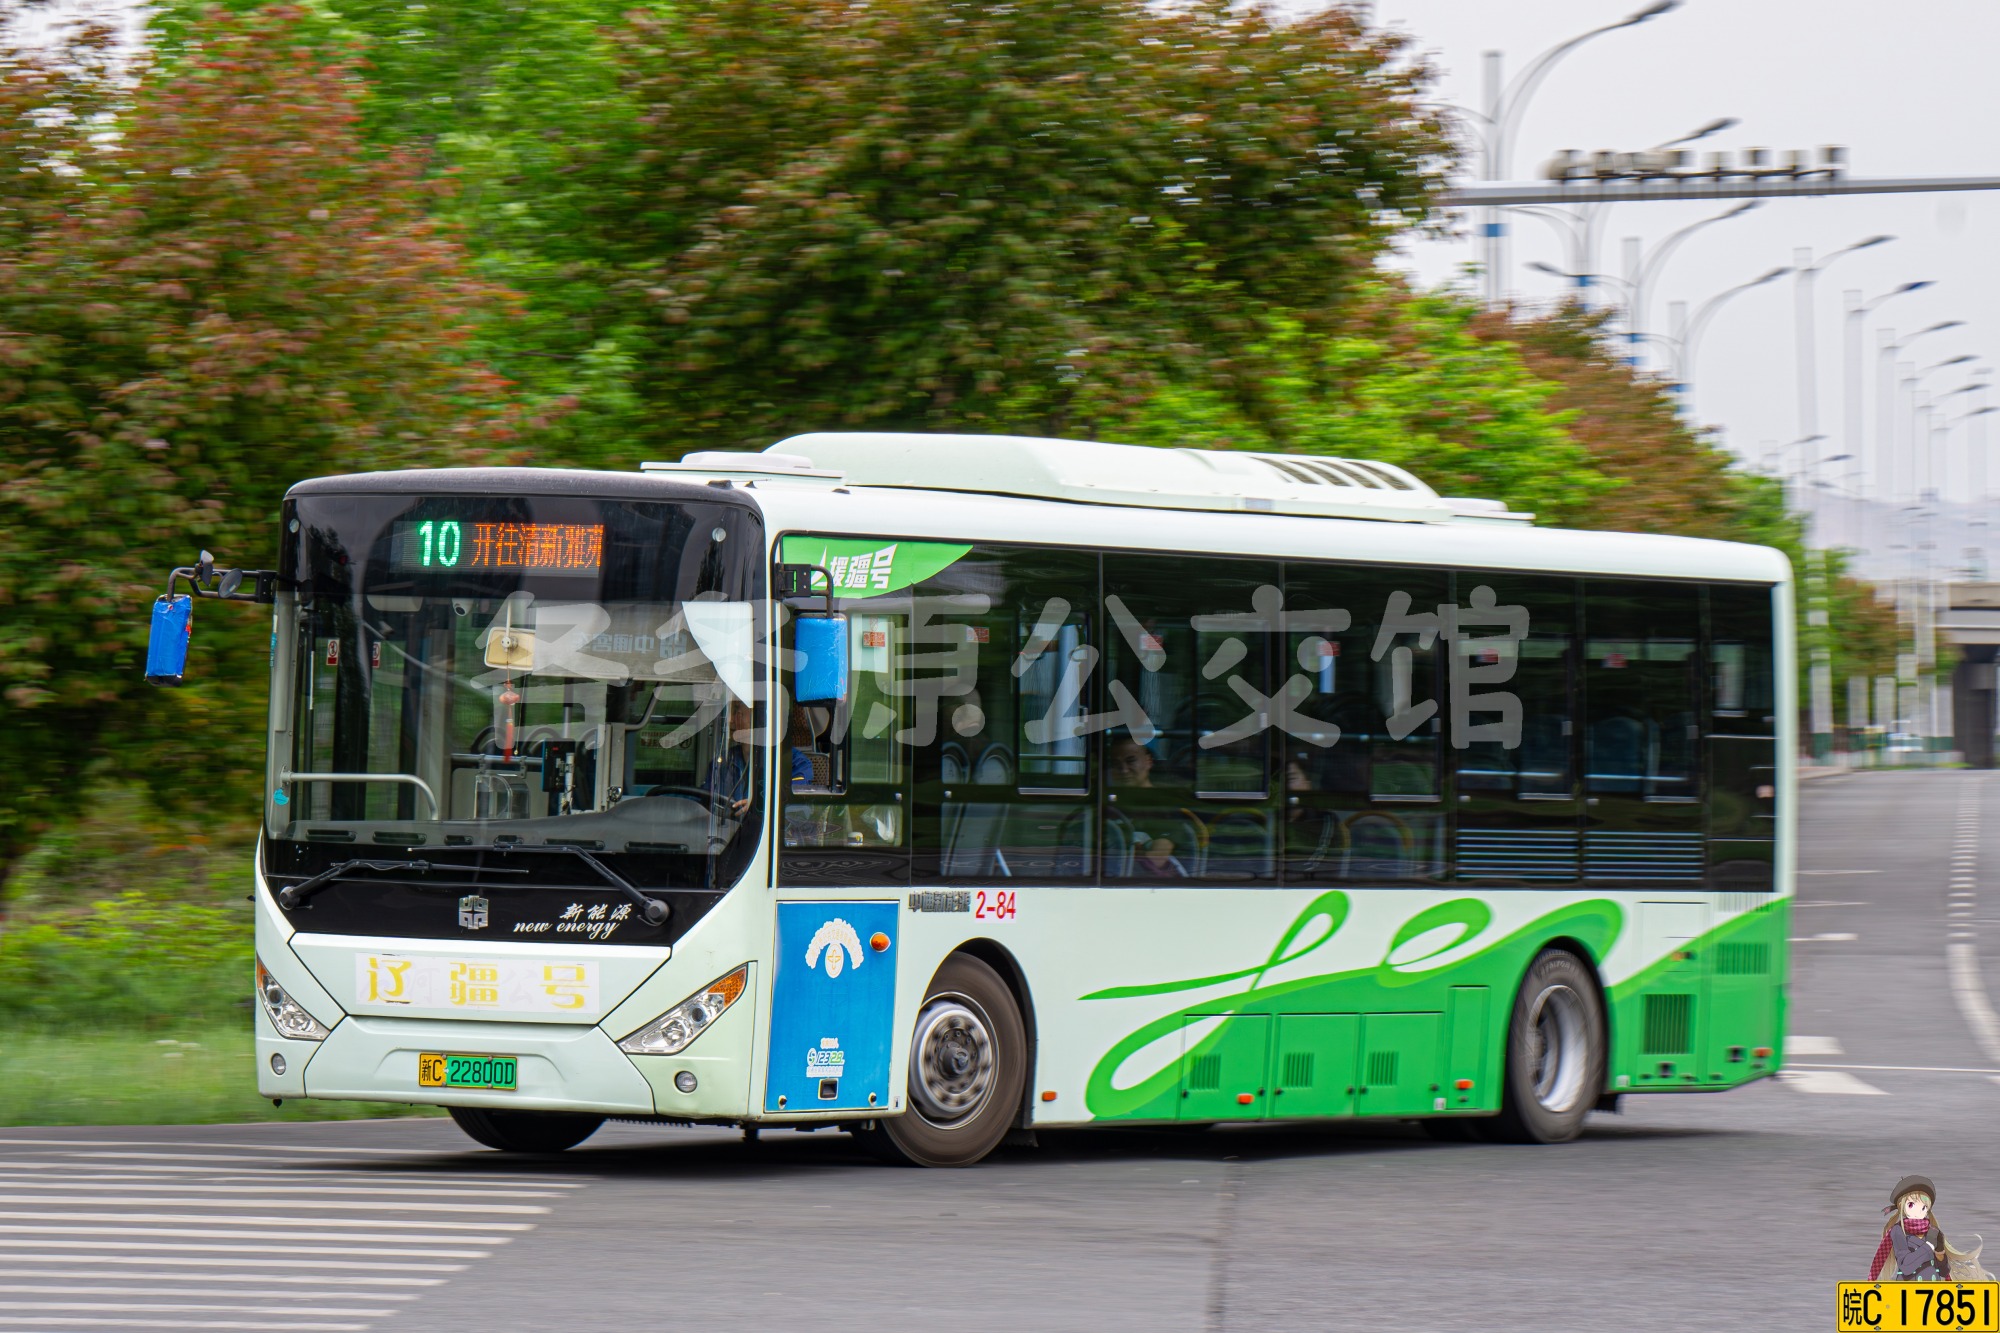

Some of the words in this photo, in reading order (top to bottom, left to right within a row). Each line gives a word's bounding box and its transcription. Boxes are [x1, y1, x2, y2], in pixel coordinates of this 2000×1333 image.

[418, 520, 461, 567] 10
[559, 902, 633, 921] 新能源
[975, 890, 1016, 919] 2-84
[513, 921, 553, 933] new
[556, 921, 620, 940] energy
